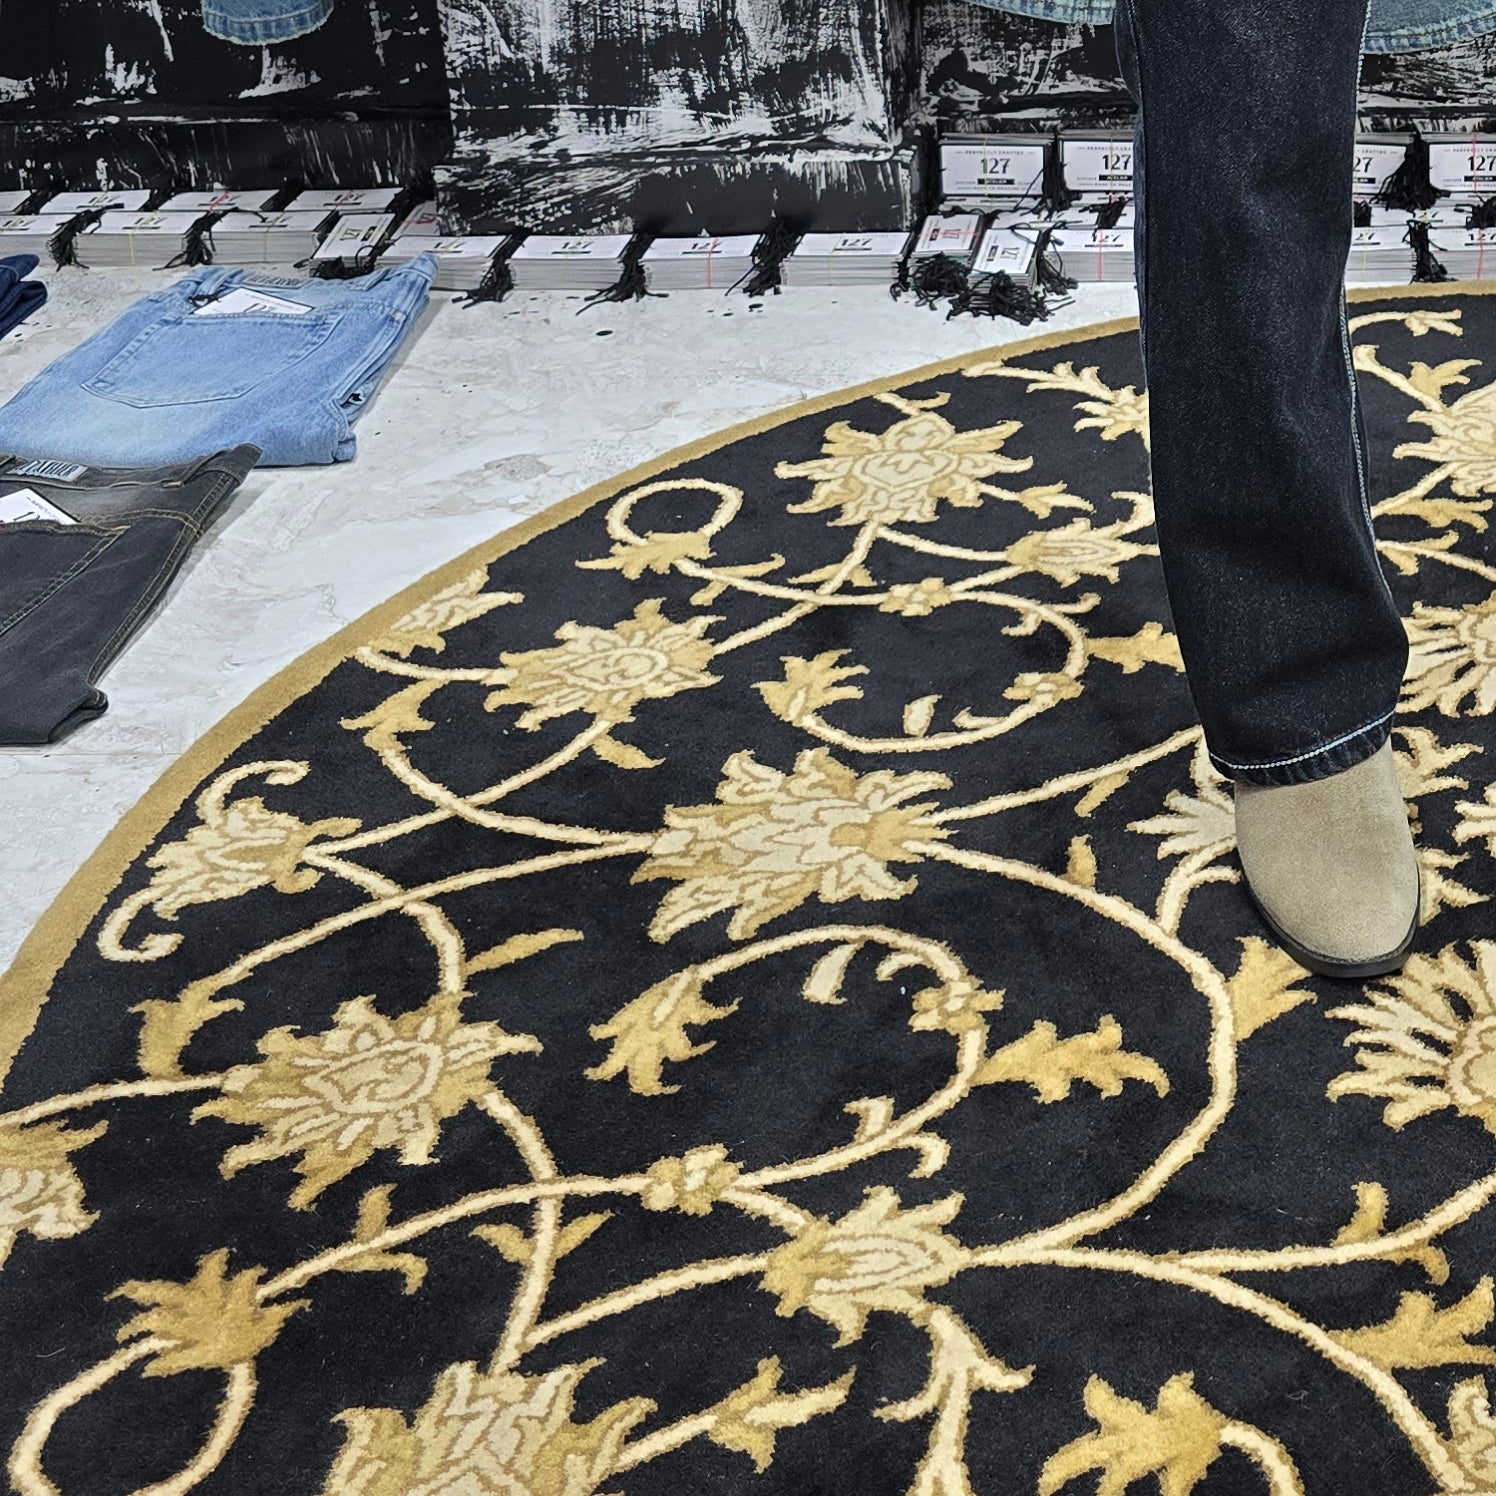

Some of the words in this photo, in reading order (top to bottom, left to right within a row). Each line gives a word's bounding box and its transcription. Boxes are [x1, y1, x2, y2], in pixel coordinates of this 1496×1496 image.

[981, 158, 1010, 174] 127
[1102, 154, 1131, 171] 127
[1353, 156, 1373, 173] 27
[1467, 155, 1496, 171] 127
[840, 237, 873, 247] 127
